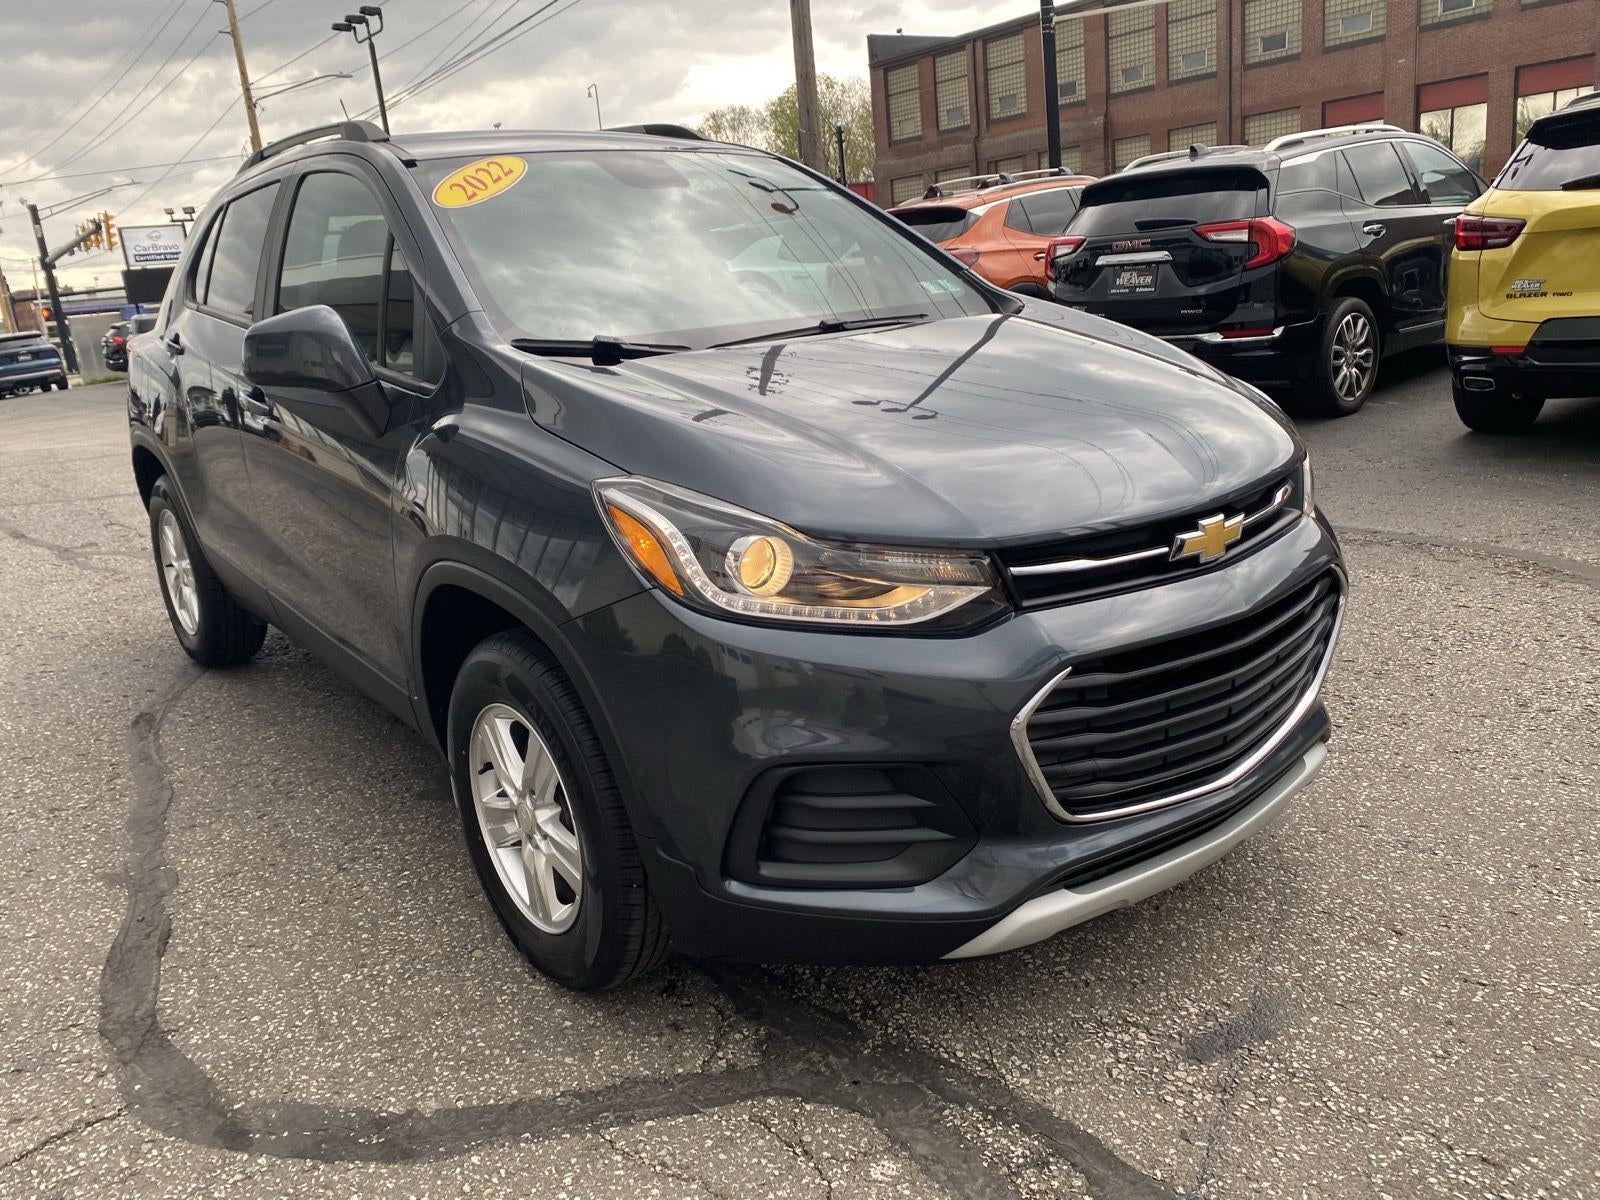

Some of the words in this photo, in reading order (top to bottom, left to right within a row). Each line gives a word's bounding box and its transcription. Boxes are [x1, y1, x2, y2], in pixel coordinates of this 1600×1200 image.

[449, 160, 514, 201] 2022
[134, 243, 179, 252] CarBravo
[1112, 239, 1151, 253] GMC
[135, 254, 165, 262] Certified
[1116, 275, 1153, 286] WEAVER
[1505, 291, 1549, 299] BLAZER
